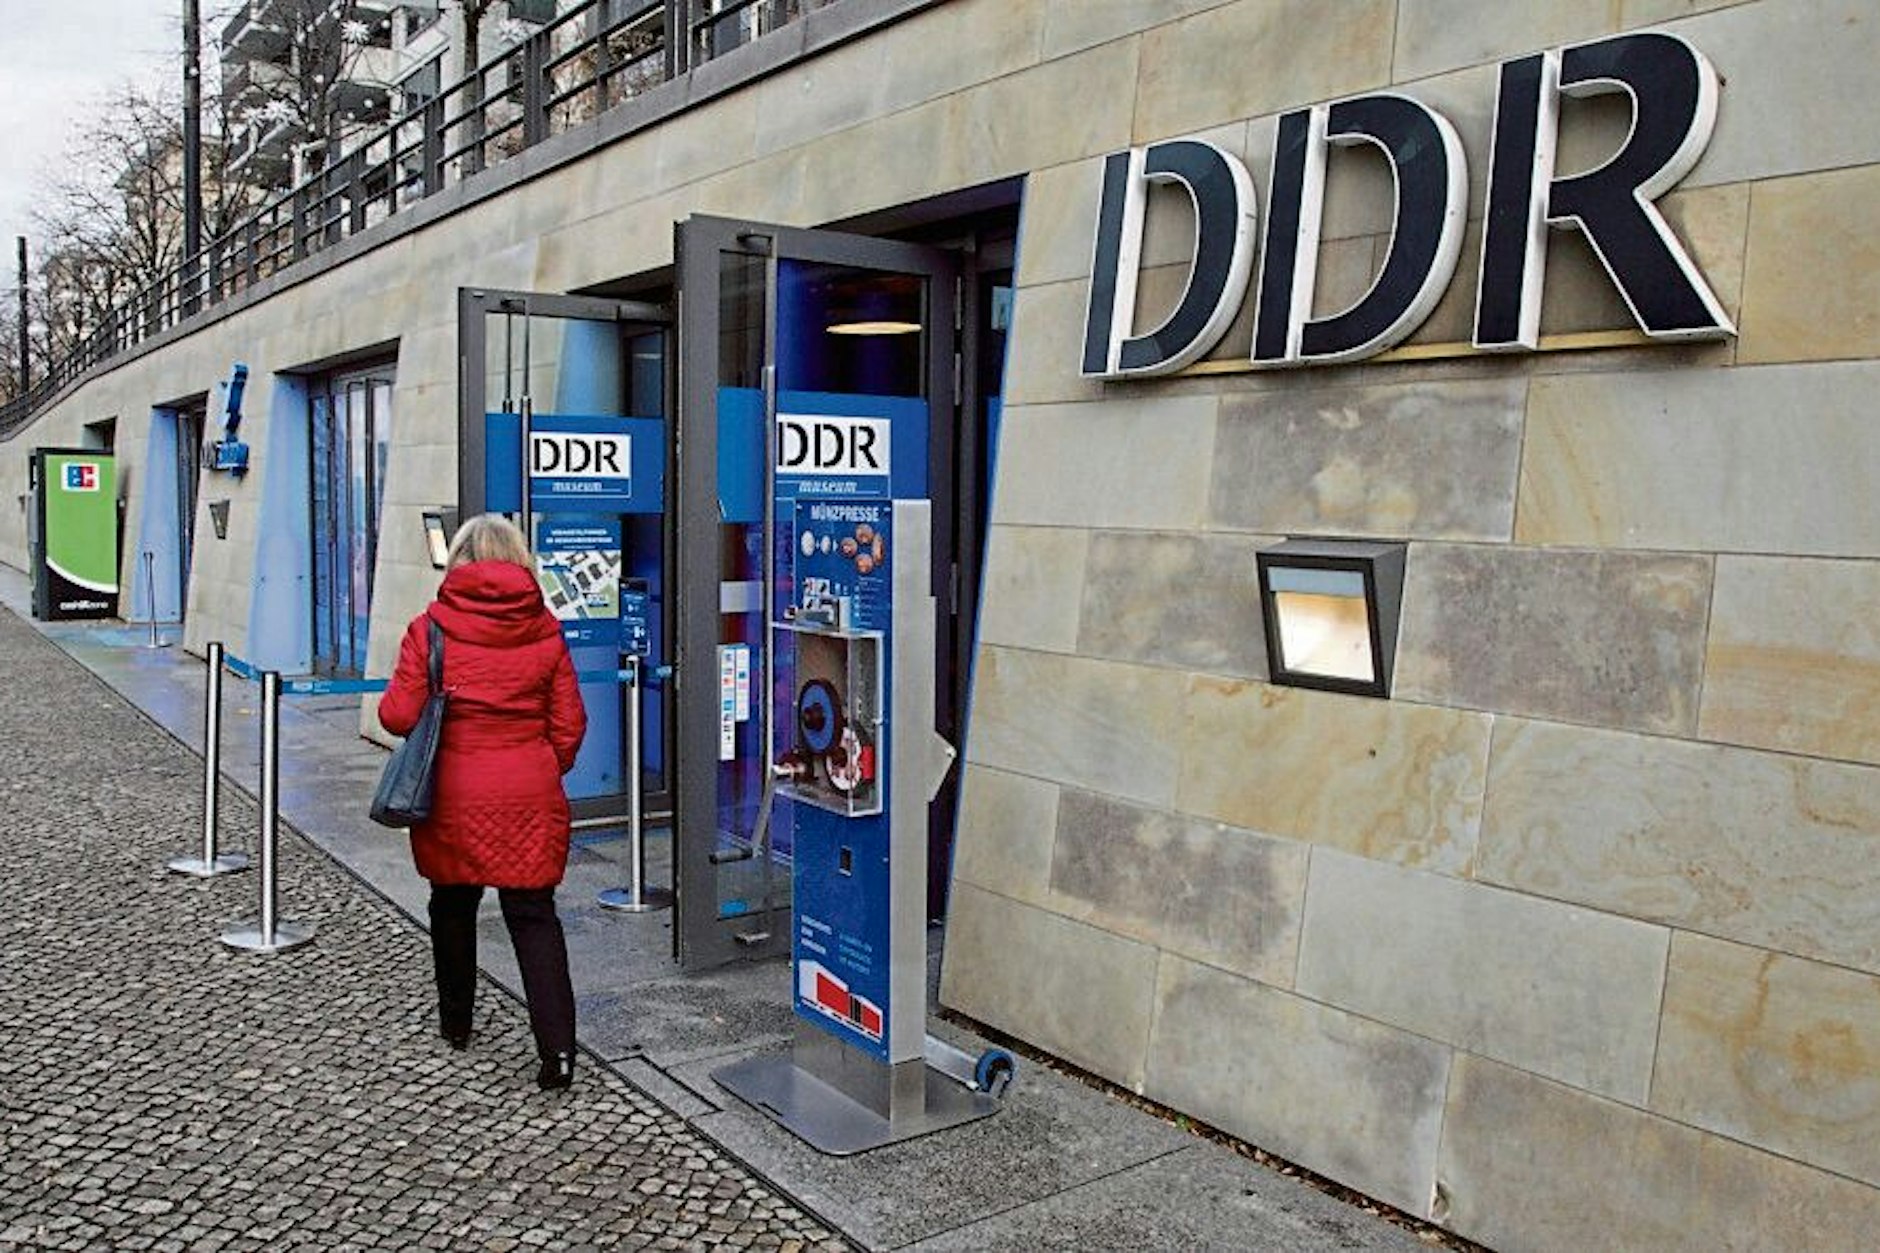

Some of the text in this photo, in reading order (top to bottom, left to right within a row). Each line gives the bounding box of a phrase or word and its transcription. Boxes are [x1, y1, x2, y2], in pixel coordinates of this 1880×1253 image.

[1082, 31, 1737, 380] DDR
[534, 438, 620, 472] DDR
[779, 422, 878, 468] DDR
[552, 481, 602, 492] museum
[799, 481, 857, 493] museum
[811, 503, 879, 522] MÜNZPRESSE
